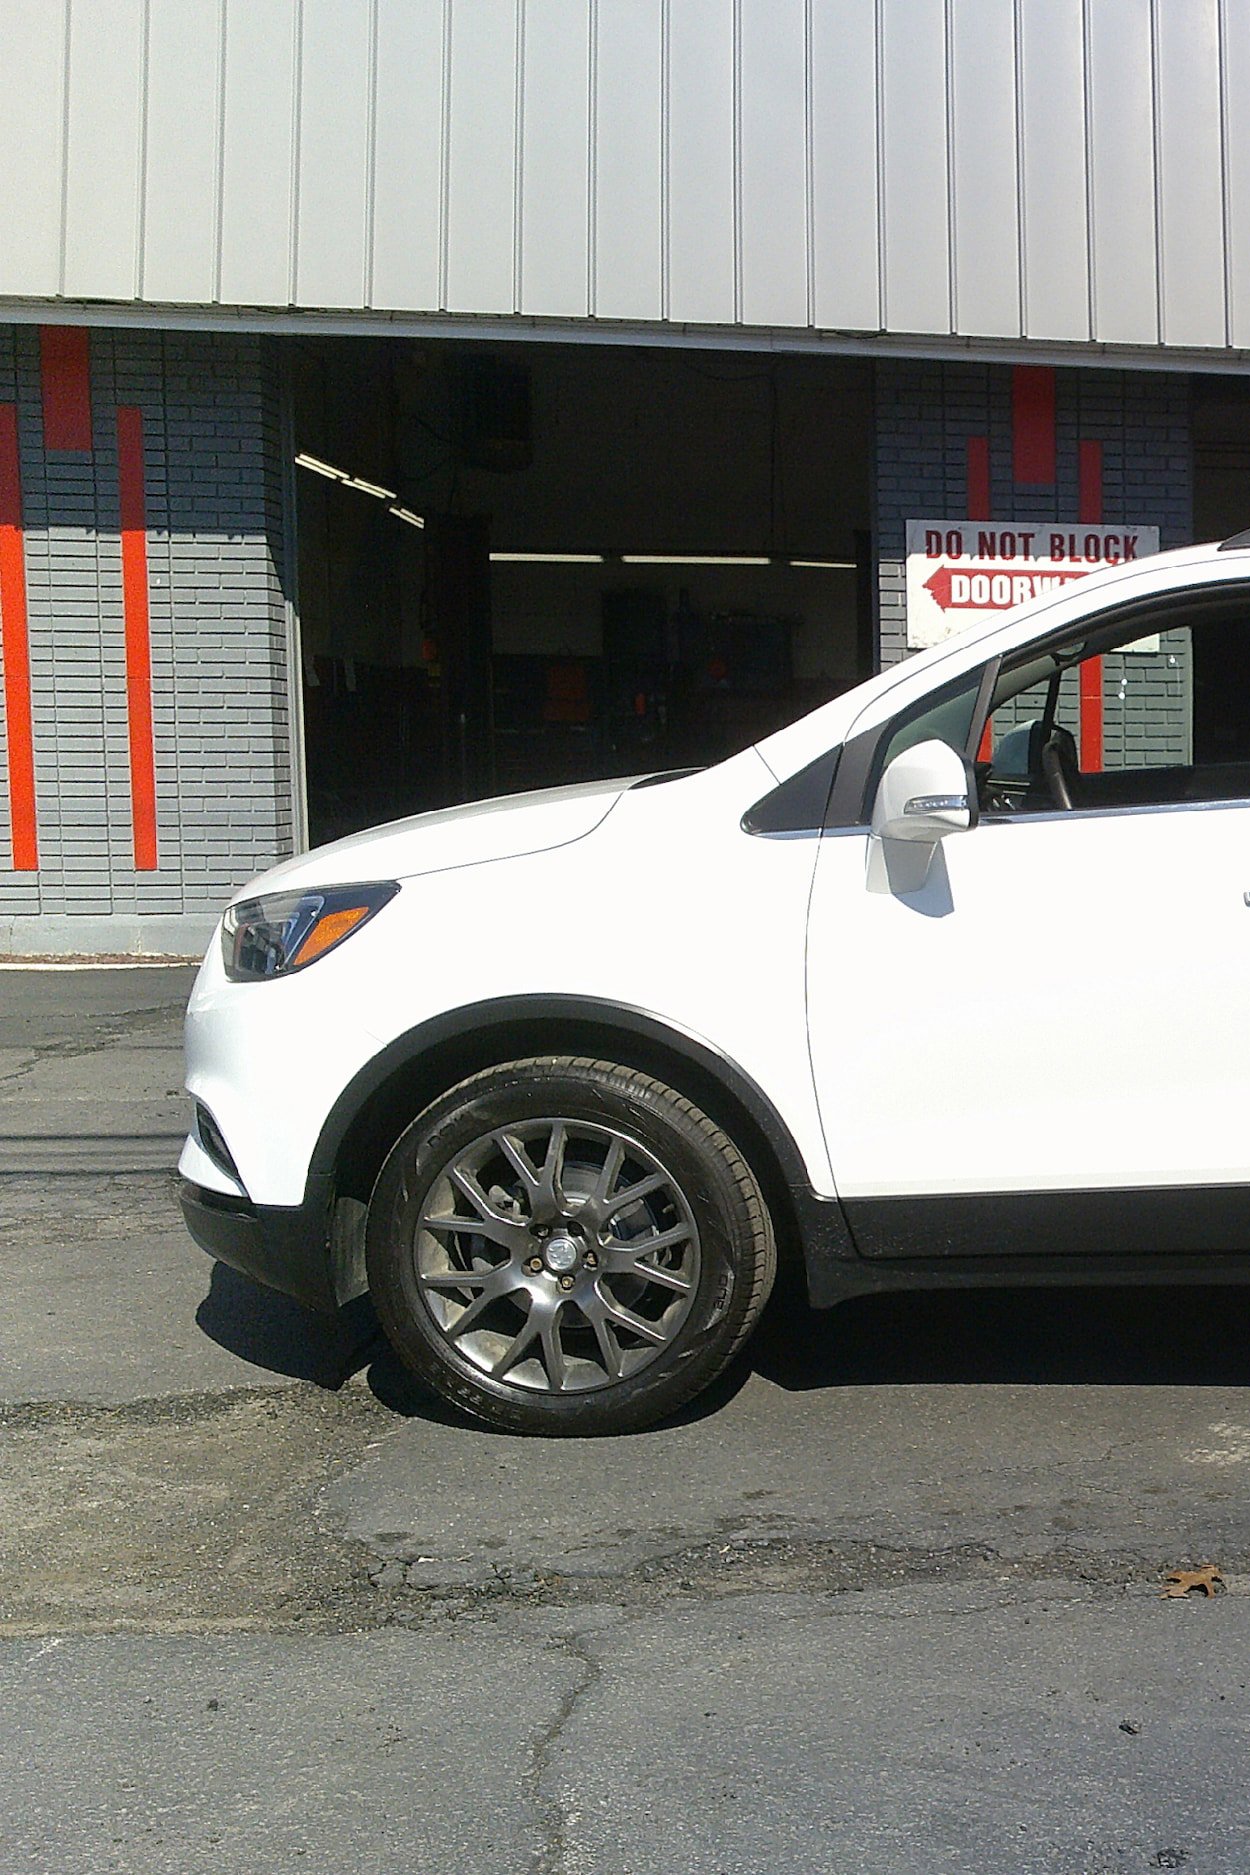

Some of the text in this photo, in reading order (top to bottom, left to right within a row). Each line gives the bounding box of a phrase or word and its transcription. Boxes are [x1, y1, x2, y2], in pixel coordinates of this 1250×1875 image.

[925, 530, 1139, 566] DO NOT BLOCK
[951, 573, 1078, 606] DOORW
